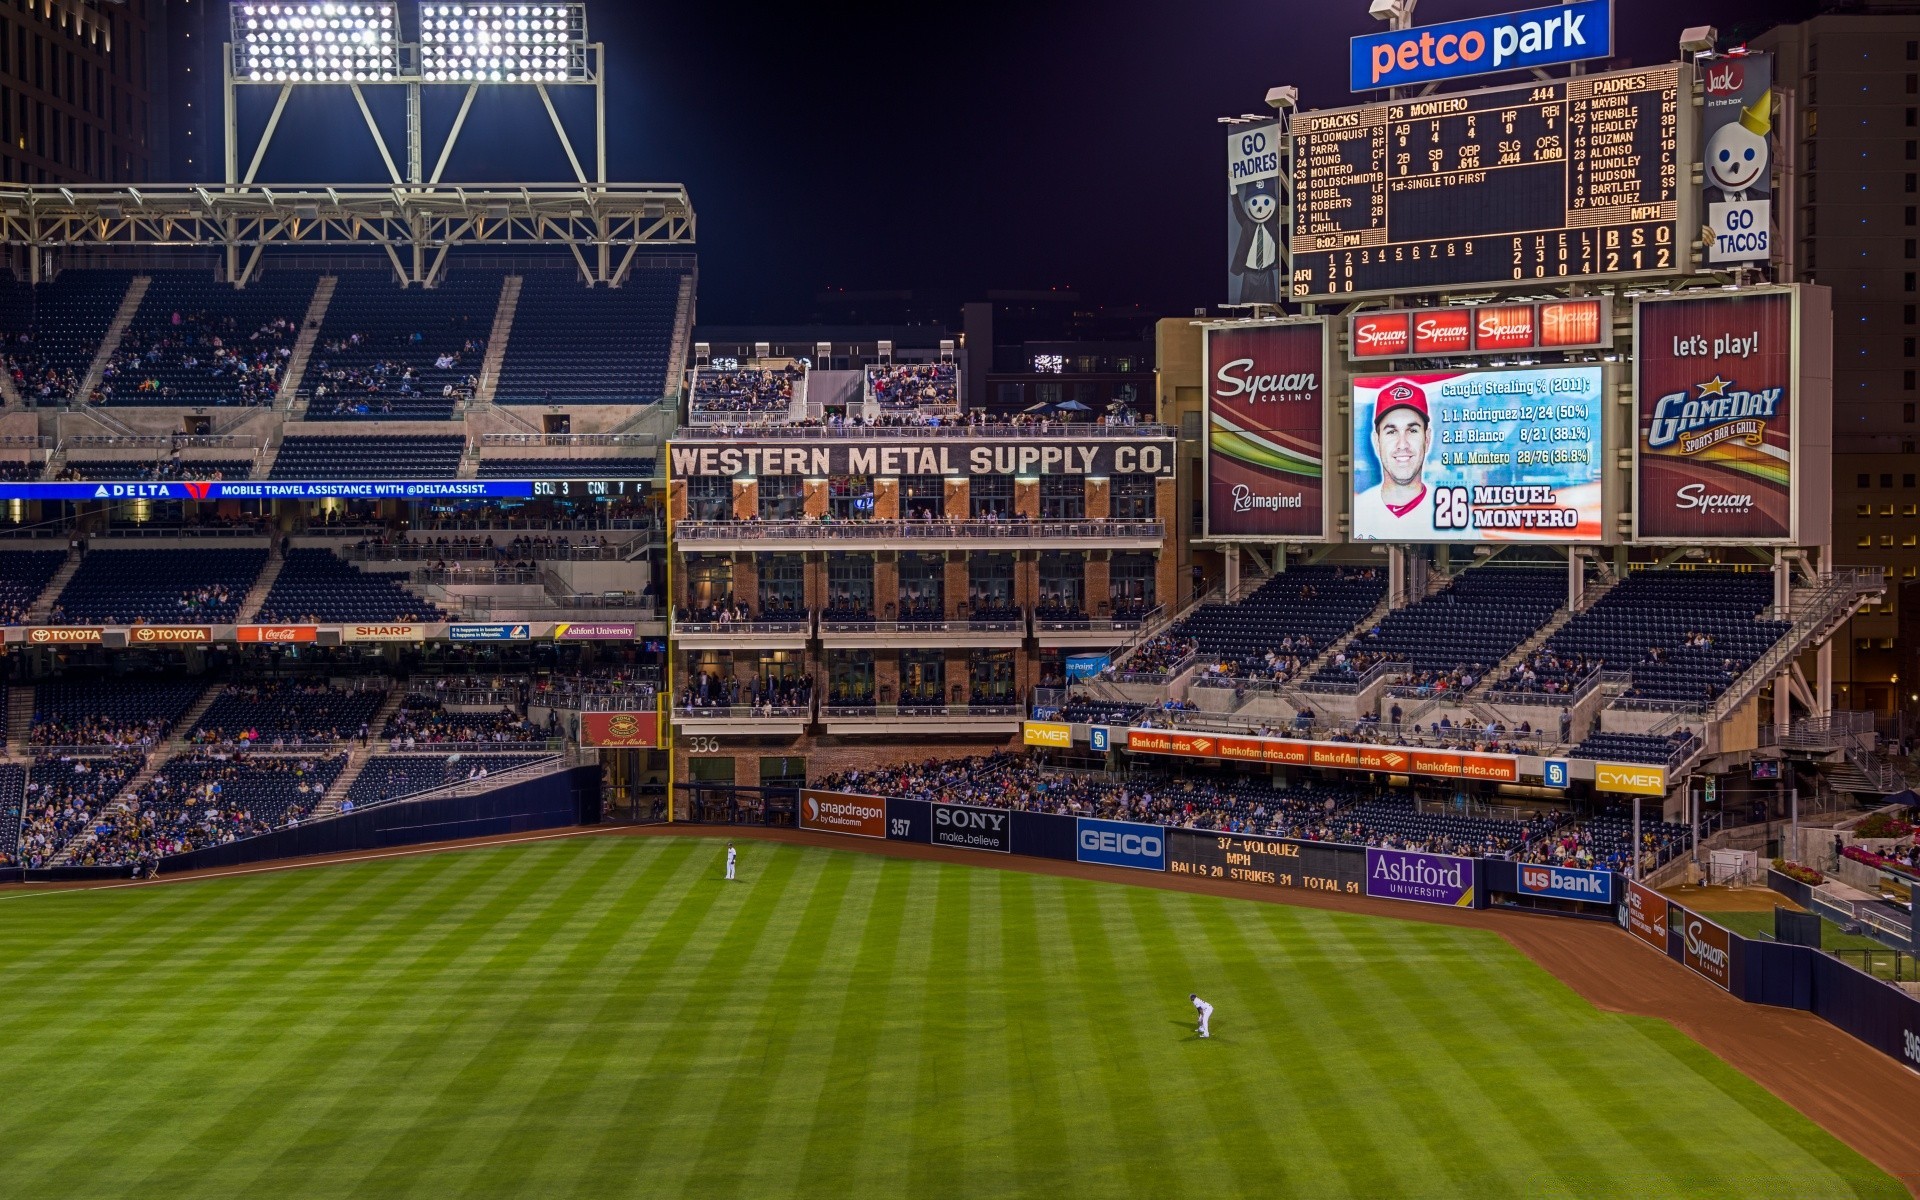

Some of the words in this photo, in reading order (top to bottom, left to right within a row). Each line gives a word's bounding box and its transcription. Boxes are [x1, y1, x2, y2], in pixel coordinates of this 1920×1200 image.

[1372, 30, 1485, 84] petco
[1493, 9, 1586, 67] park
[1593, 75, 1646, 95] PADRES
[1707, 65, 1742, 92] Jack
[1389, 107, 1404, 120] 26
[1410, 98, 1468, 117] MONTERO
[1528, 87, 1554, 101] .444
[1591, 95, 1628, 109] MAYBIN
[1311, 113, 1358, 131] D'BACKS
[1591, 106, 1638, 121] VENABLE
[1591, 118, 1638, 134] HEADLEY
[1242, 132, 1266, 156] GO
[1311, 128, 1368, 144] BLOOMQUIST
[1591, 131, 1633, 146] GUZMAN
[1311, 143, 1339, 155] PARRA
[1459, 145, 1480, 157] OBP
[1499, 140, 1521, 152] SLG
[1536, 136, 1559, 149] OPS
[1590, 144, 1632, 158] ALONSO
[1233, 152, 1277, 178] PADRES
[1310, 154, 1341, 167] YOUNG
[1457, 157, 1480, 169] .615
[1498, 153, 1521, 165] .444
[1533, 147, 1562, 161] 1.060
[1591, 155, 1641, 171] HUNDLEY
[1311, 164, 1353, 178] MONTERO
[1591, 168, 1636, 182] HUDSON
[1391, 175, 1441, 191] 1st-SINGLE
[1444, 174, 1456, 186] TO
[1458, 172, 1486, 185] FIRST
[1591, 180, 1641, 195] BARTLETT
[1311, 188, 1341, 200] KUBEL
[1590, 192, 1640, 207] VOLQUEZ
[1311, 198, 1352, 211] ROBERTS
[1631, 205, 1661, 220] MPH
[1311, 211, 1330, 222] HILL
[1727, 209, 1754, 231] GO
[1311, 222, 1341, 233] CAHILL
[1606, 230, 1619, 246] B
[1631, 227, 1644, 244] S
[1656, 225, 1670, 243] O
[1316, 236, 1336, 248] 8:02
[1343, 234, 1360, 246] PM
[1717, 231, 1767, 253] TACOS
[1607, 252, 1619, 271] 2
[1632, 250, 1642, 269] 1
[1656, 249, 1670, 267] 2
[1294, 269, 1312, 281] ARI
[1294, 284, 1309, 296] SD
[1358, 324, 1407, 349] Sycuan
[1416, 319, 1469, 342] Sycuan
[1478, 317, 1533, 341] Sycuan
[1673, 334, 1708, 357] let's
[1714, 331, 1759, 359] play!
[1216, 358, 1318, 404] Sycuan
[1442, 381, 1482, 398] Caught
[1485, 380, 1534, 396] Stealing
[1536, 379, 1547, 392] %
[1550, 377, 1590, 393] (2011):
[1261, 393, 1312, 402] CASINO
[1442, 409, 1451, 422] 1.
[1462, 407, 1518, 423] Rodriguez
[1520, 405, 1553, 421] 12/24
[1556, 404, 1589, 420] (50%)
[1442, 431, 1453, 443] 2.
[1454, 430, 1466, 442] H.
[1467, 429, 1505, 442] Blanco
[1520, 427, 1547, 443] 8/21
[1549, 426, 1591, 443] (38.1%)
[1686, 433, 1713, 453] SPORTS
[1714, 427, 1729, 441] BAR
[1736, 421, 1758, 434] GRILL
[671, 447, 830, 475] WESTERN
[848, 446, 959, 474] METAL
[970, 445, 1099, 474] SUPPLY
[1115, 445, 1171, 473] CO.
[1442, 452, 1451, 465] 3.
[1453, 452, 1466, 464] M.
[1467, 451, 1510, 464] Montero
[1517, 450, 1549, 466] 28/76
[1550, 449, 1591, 465] (36.8%)
[113, 485, 170, 496] DELTA
[221, 486, 262, 495] MOBILE
[264, 485, 305, 495] TRAVEL
[307, 485, 373, 494] ASSISTANCE
[374, 485, 404, 494] WITH
[406, 484, 487, 495] @DELTAASSIST.
[562, 482, 569, 494] 3
[637, 483, 642, 493] F
[1473, 486, 1556, 504] MIGUEL
[1232, 484, 1302, 512] Reimagined
[1676, 483, 1754, 514] Sycuan
[1435, 487, 1468, 528] 26
[1473, 509, 1578, 528] MONTERO
[51, 630, 100, 640] TOYOTA
[156, 629, 205, 640] TOYOTA
[356, 626, 412, 636] SHARP
[567, 626, 594, 636] Ashford
[596, 626, 633, 637] University
[1074, 662, 1094, 670] Paint
[1025, 729, 1069, 741] CYMER
[689, 735, 719, 753] 336
[1132, 737, 1150, 748] Bank
[1151, 738, 1158, 748] of
[1158, 739, 1190, 751] America
[1222, 745, 1304, 761] bankofamerica.com
[1314, 751, 1335, 764] Bank
[1335, 752, 1344, 764] of
[1344, 753, 1381, 767] America
[1416, 760, 1510, 778] bankofamerica.com
[1598, 772, 1661, 788] CYMER
[820, 801, 883, 821] snapdragon
[936, 808, 1005, 831] SONY
[820, 815, 828, 823] by
[828, 815, 862, 827] Qualcomm
[891, 818, 910, 837] 357
[940, 831, 999, 847] make.believe
[1080, 829, 1162, 858] GEICO
[1226, 852, 1251, 866] MPH
[1211, 865, 1223, 878] 20
[1230, 868, 1275, 884] STRIKES
[1280, 873, 1292, 886] 31
[1303, 876, 1341, 892] TOTAL
[1346, 881, 1359, 894] 51
[1373, 854, 1462, 889] Ashford
[1390, 884, 1448, 899] UNIVERSITY
[1619, 904, 1629, 929] 401
[1688, 920, 1725, 969] Sycuan
[1704, 961, 1723, 977] CASINO
[1904, 1029, 1920, 1064] 396
